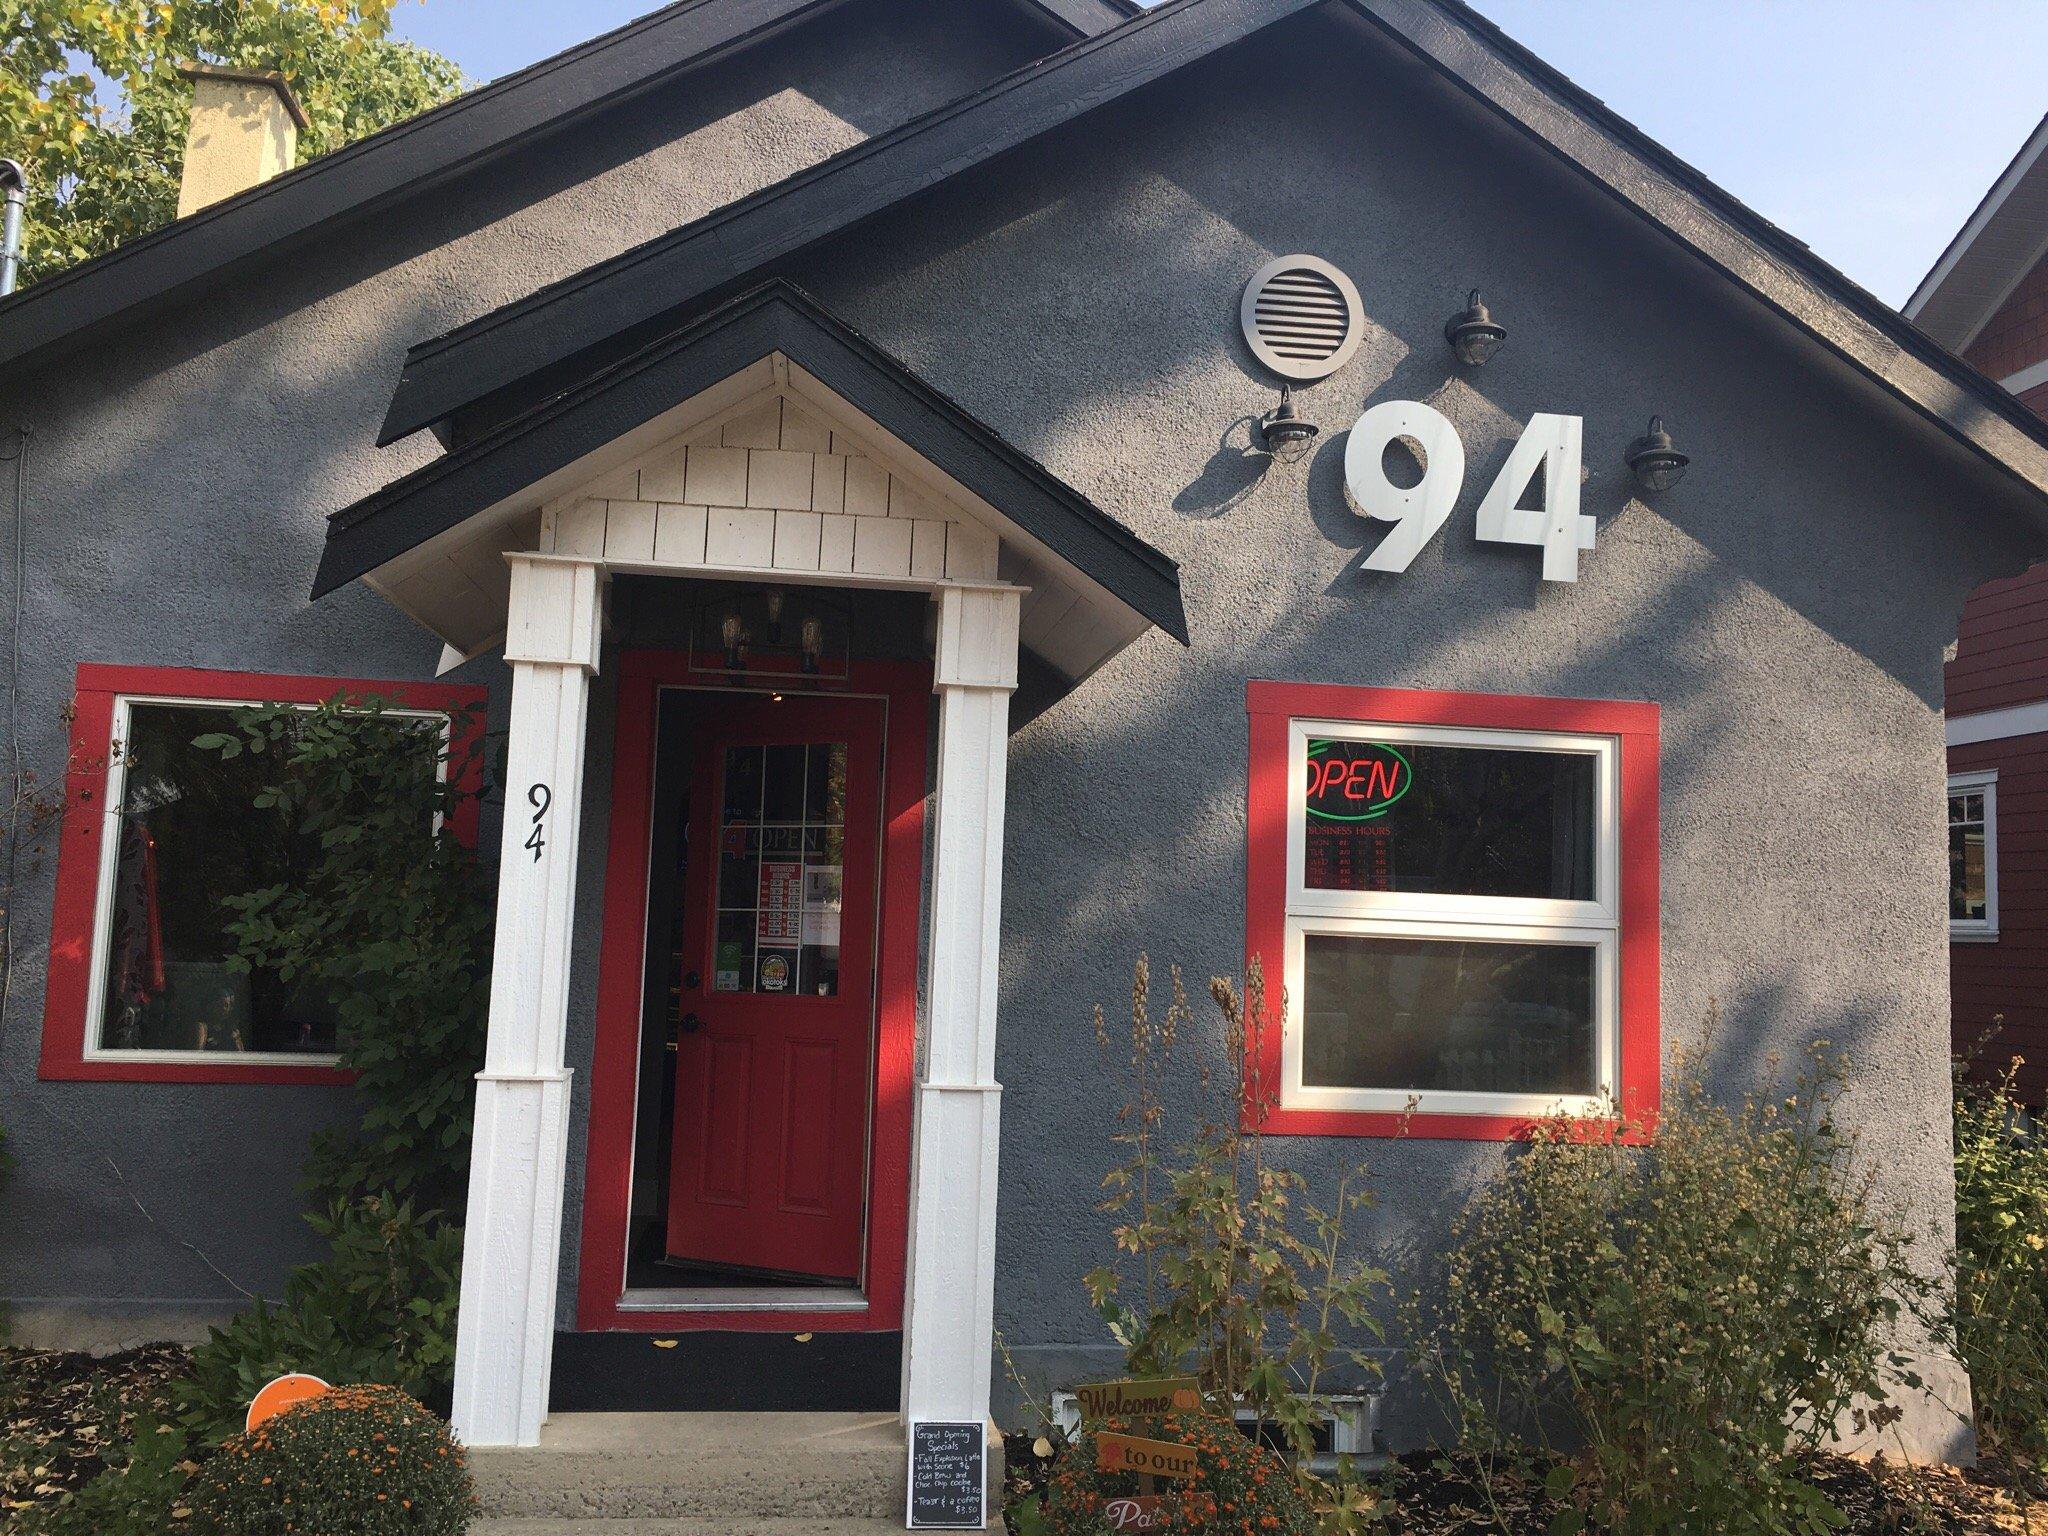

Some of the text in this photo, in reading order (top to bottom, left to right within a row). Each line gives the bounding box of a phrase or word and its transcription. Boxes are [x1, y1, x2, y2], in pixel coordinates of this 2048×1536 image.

[1344, 399, 1597, 583] 94
[524, 783, 552, 864] 94
[1308, 826, 1392, 837] BUSINESS HOURS
[752, 827, 818, 850] OPEN
[1078, 1386, 1172, 1418] Welcome
[916, 1430, 941, 1440] Grand
[927, 1440, 959, 1454] Specials
[1125, 1446, 1195, 1473] to our
[955, 1505, 978, 1515] $3.50
